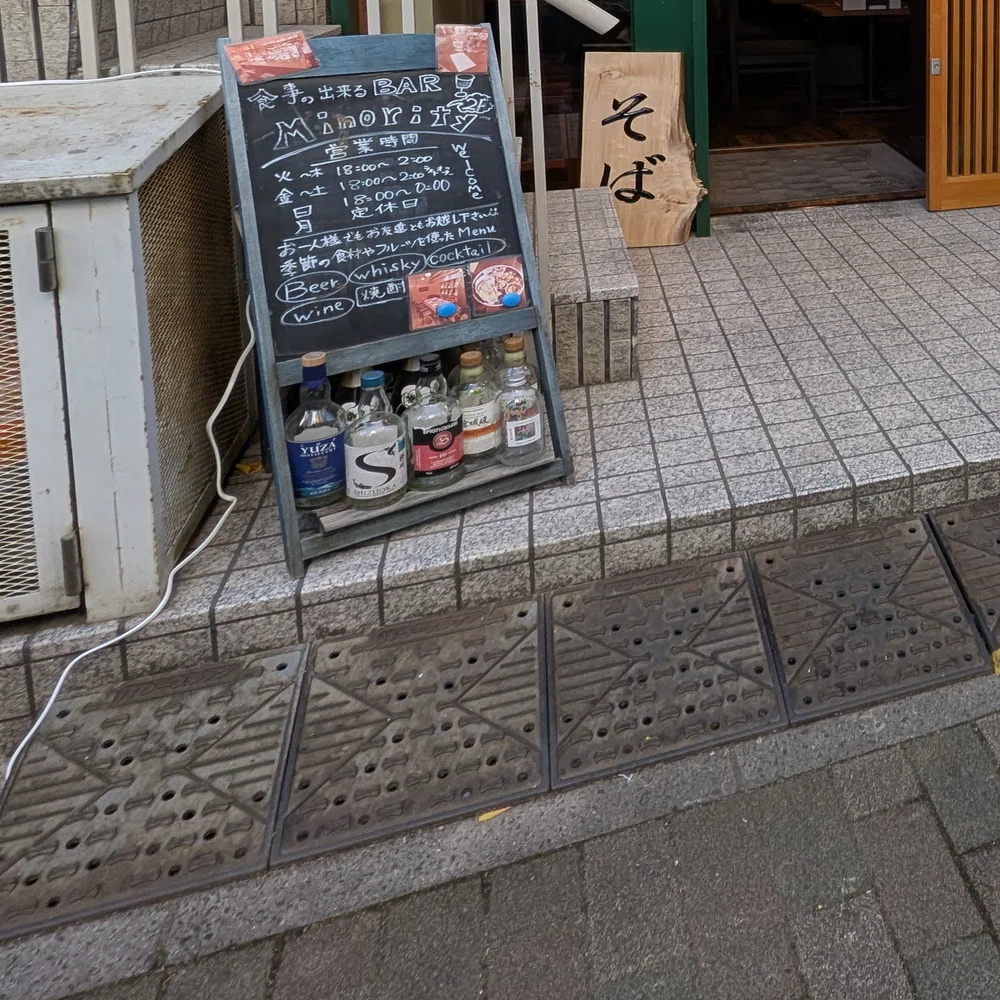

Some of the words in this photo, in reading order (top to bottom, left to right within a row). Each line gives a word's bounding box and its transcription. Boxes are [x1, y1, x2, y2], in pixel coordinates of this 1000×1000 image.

[273, 105, 478, 150] Minority
[325, 134, 418, 160] 営業時間
[602, 93, 666, 203] そば
[293, 204, 312, 219] 日
[294, 219, 312, 235] 月
[351, 198, 418, 221] 定休日
[428, 241, 491, 265] cocktail
[353, 257, 421, 280] whisky
[285, 279, 340, 301] Beer
[360, 281, 406, 300] 焼酎
[293, 300, 344, 323] wine
